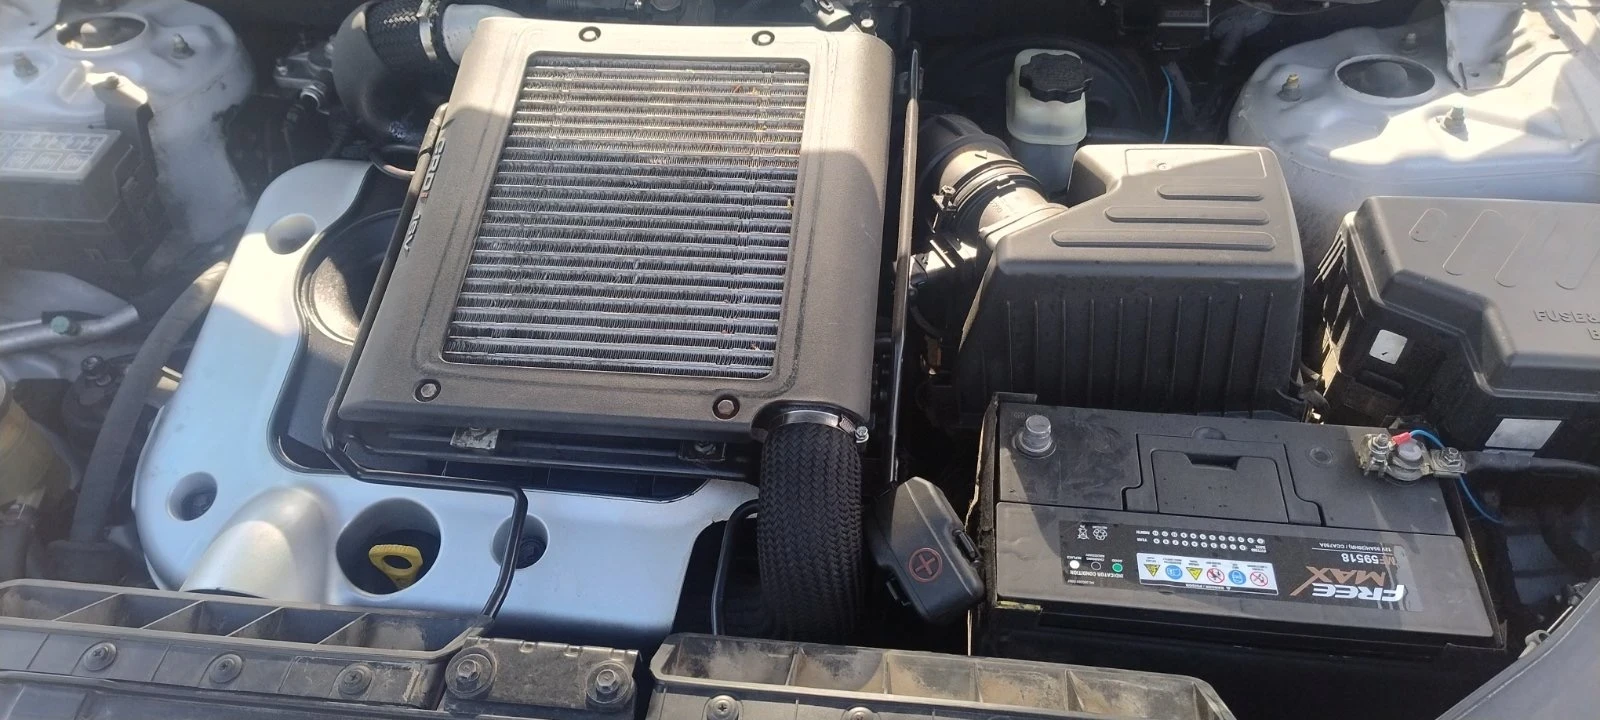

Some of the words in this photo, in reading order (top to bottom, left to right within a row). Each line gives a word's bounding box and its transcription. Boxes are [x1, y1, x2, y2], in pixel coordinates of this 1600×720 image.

[404, 213, 422, 253] 16V
[1340, 552, 1397, 566] MF59518
[1289, 565, 1386, 596] MAX
[1311, 582, 1405, 602] FREE
